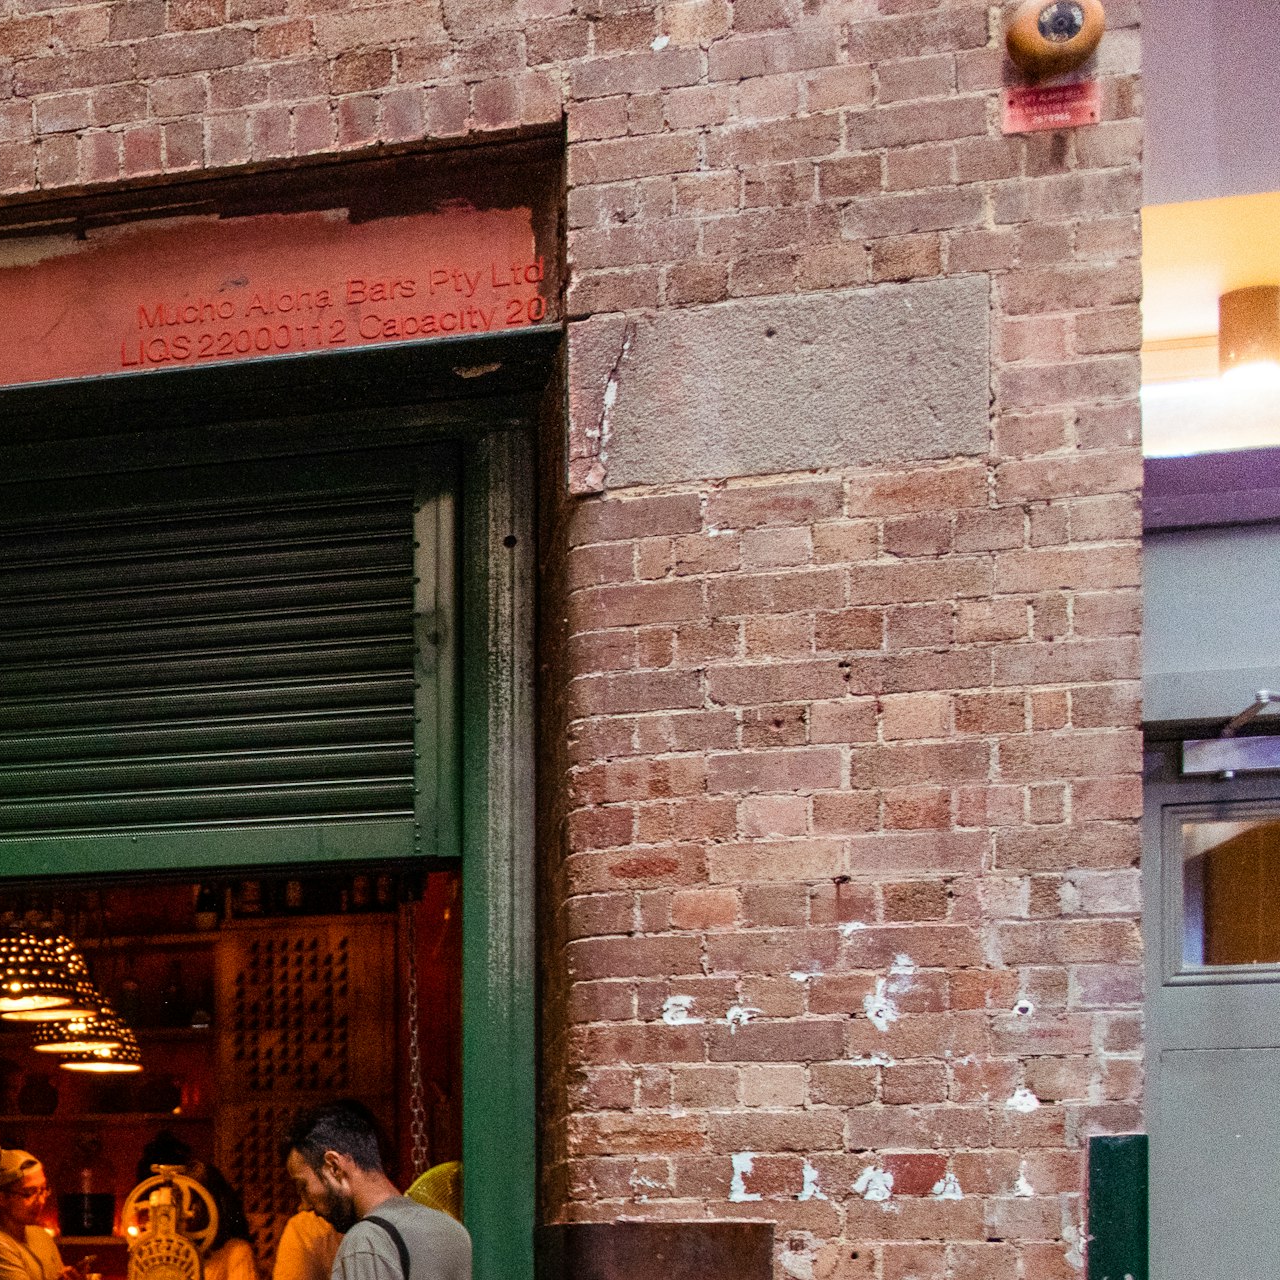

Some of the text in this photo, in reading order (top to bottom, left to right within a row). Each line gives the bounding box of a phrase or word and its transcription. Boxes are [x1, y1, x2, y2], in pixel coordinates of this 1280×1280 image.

[138, 255, 544, 330] Mucho Aloha Bars Pty Ltd
[358, 304, 496, 341] Capacity
[506, 294, 546, 326] 20
